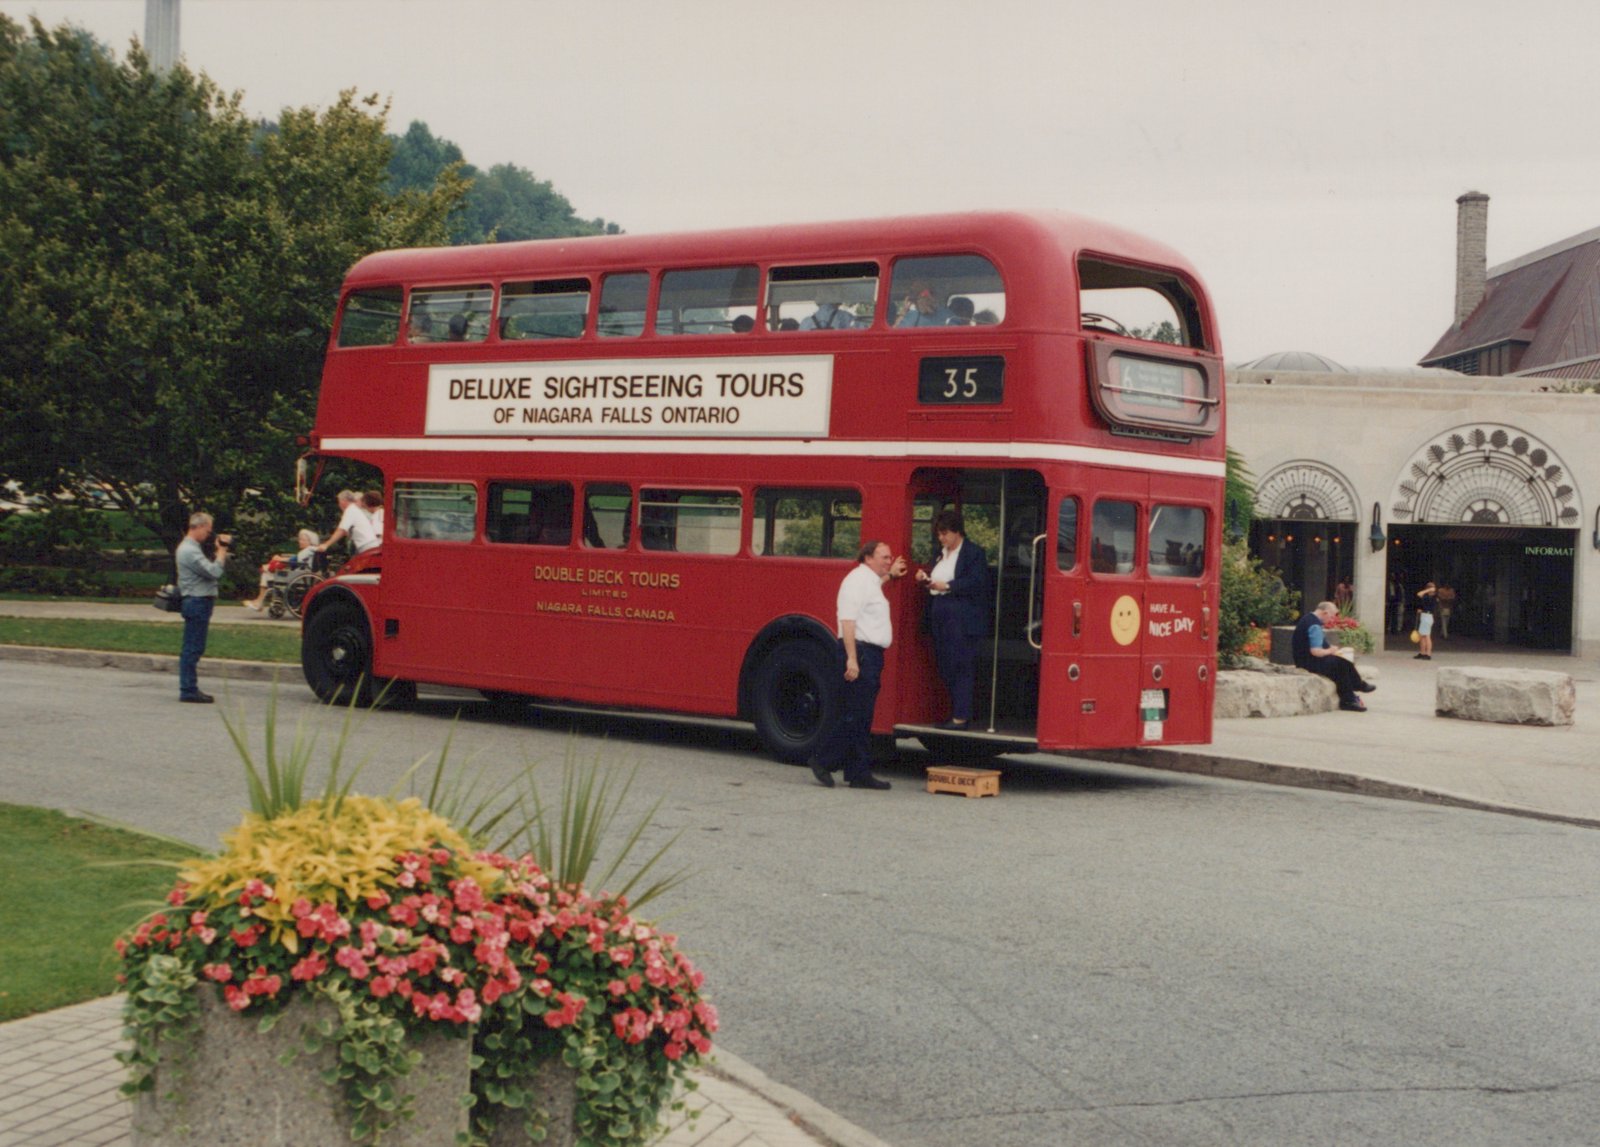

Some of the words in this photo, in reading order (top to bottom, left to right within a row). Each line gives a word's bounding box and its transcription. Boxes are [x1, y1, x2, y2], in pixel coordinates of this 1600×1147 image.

[449, 377, 532, 400] DELUXE
[543, 375, 703, 399] SIGHTSEEING
[716, 373, 804, 397] TOURS
[943, 368, 978, 398] 35
[493, 408, 515, 424] OF
[522, 407, 593, 424] NIAGARA
[601, 407, 652, 424] FALLS
[662, 406, 740, 424] ONTARIO
[534, 566, 584, 582] DOUBLE
[588, 569, 623, 584] DECK
[629, 571, 680, 588] TOURS
[582, 588, 628, 599] LIMITED
[536, 601, 582, 613] NIAGARA
[625, 607, 675, 621] CANADA
[1150, 604, 1167, 614] HAVE
[1149, 620, 1172, 638] NICE
[1174, 617, 1195, 633] DAY
[929, 774, 956, 785] DOUBLE
